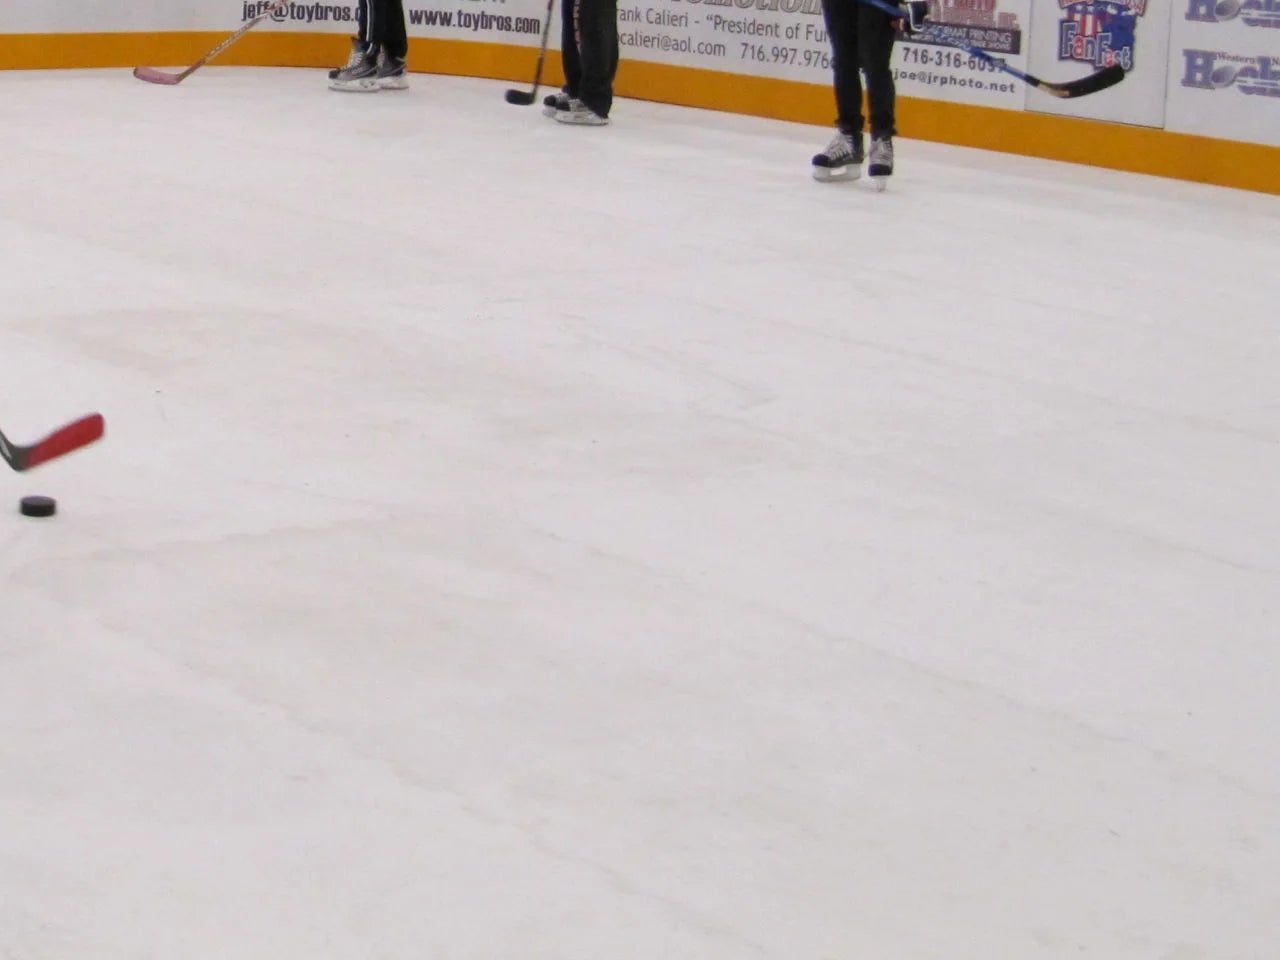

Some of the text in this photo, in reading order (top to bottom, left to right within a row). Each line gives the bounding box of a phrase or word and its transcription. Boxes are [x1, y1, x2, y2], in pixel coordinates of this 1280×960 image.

[409, 7, 541, 35] www.toybros.com
[646, 8, 689, 28] Calieri
[786, 23, 801, 40] of
[617, 30, 726, 57] calieri@aol.com
[1218, 51, 1256, 64] Western
